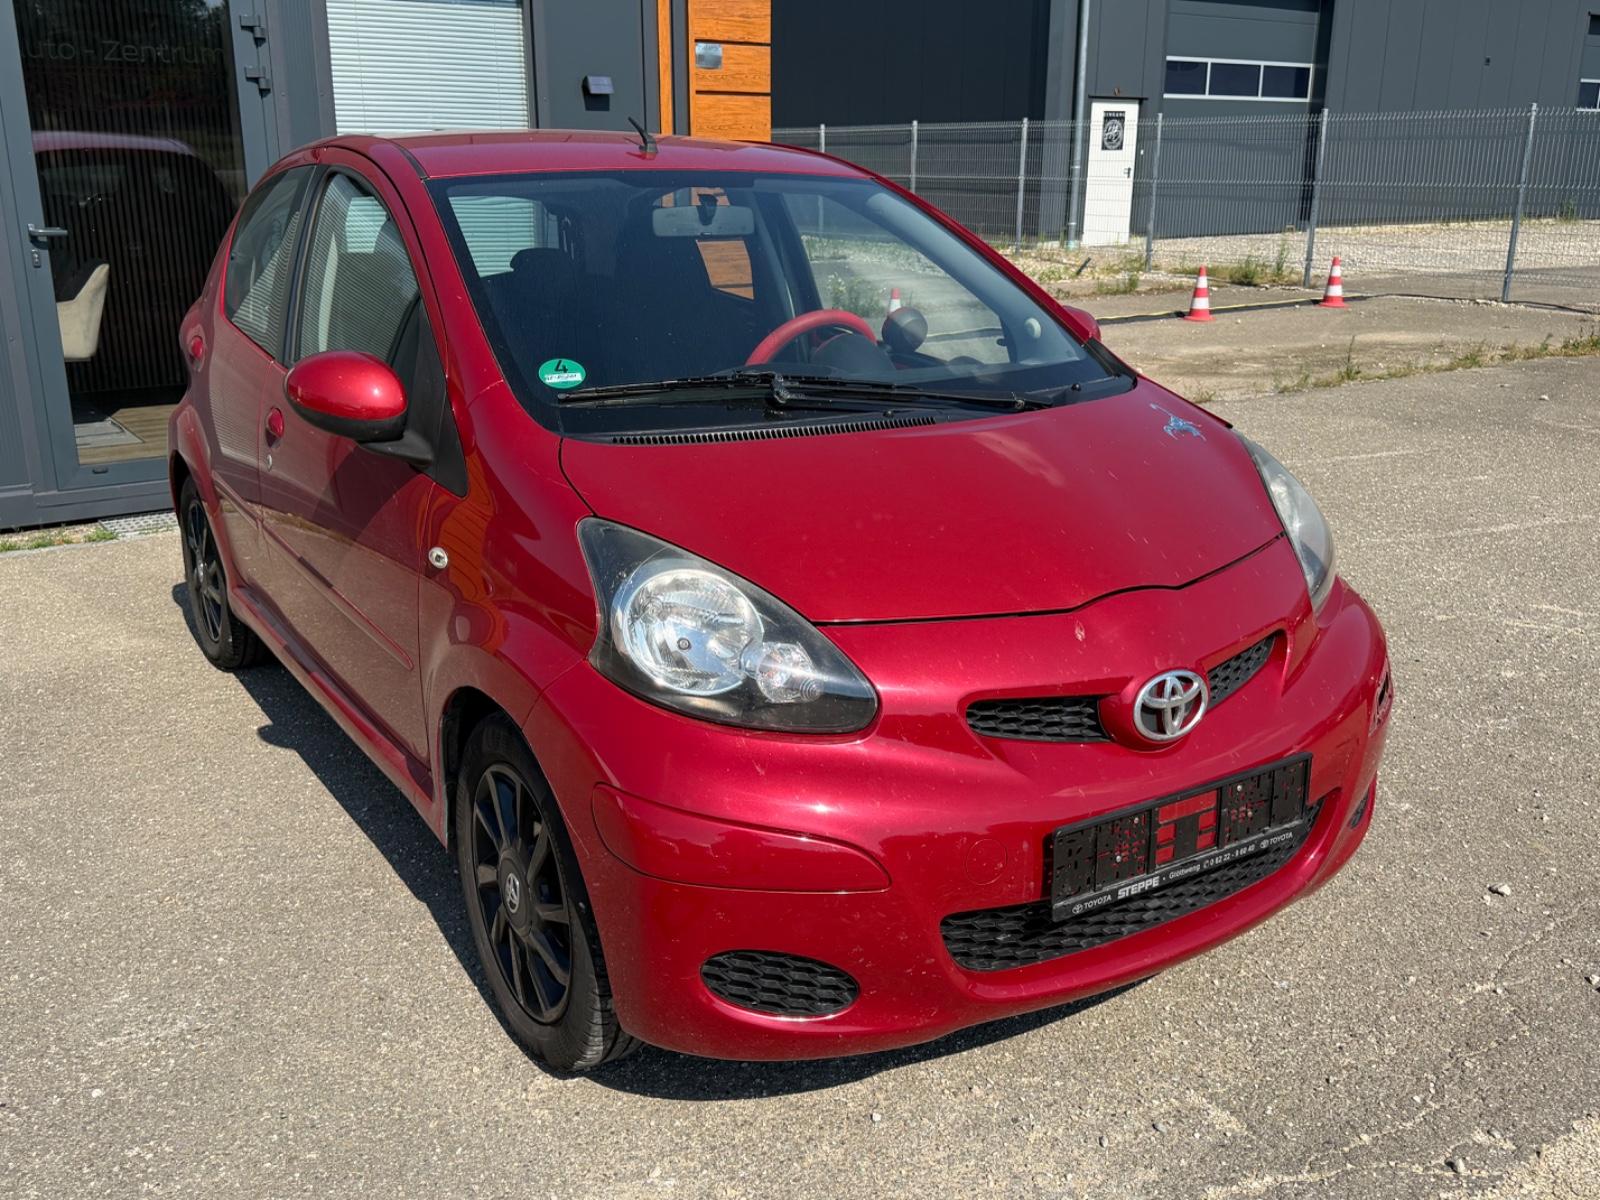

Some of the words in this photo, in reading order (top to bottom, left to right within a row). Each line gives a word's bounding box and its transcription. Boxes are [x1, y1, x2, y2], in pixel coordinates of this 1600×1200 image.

[24, 39, 76, 60] uto
[101, 39, 224, 66] Zentrum
[554, 360, 569, 373] 4
[1083, 894, 1112, 910] TOYOTA
[1117, 876, 1160, 900] STEPPE
[1270, 832, 1293, 845] TOYOTA
